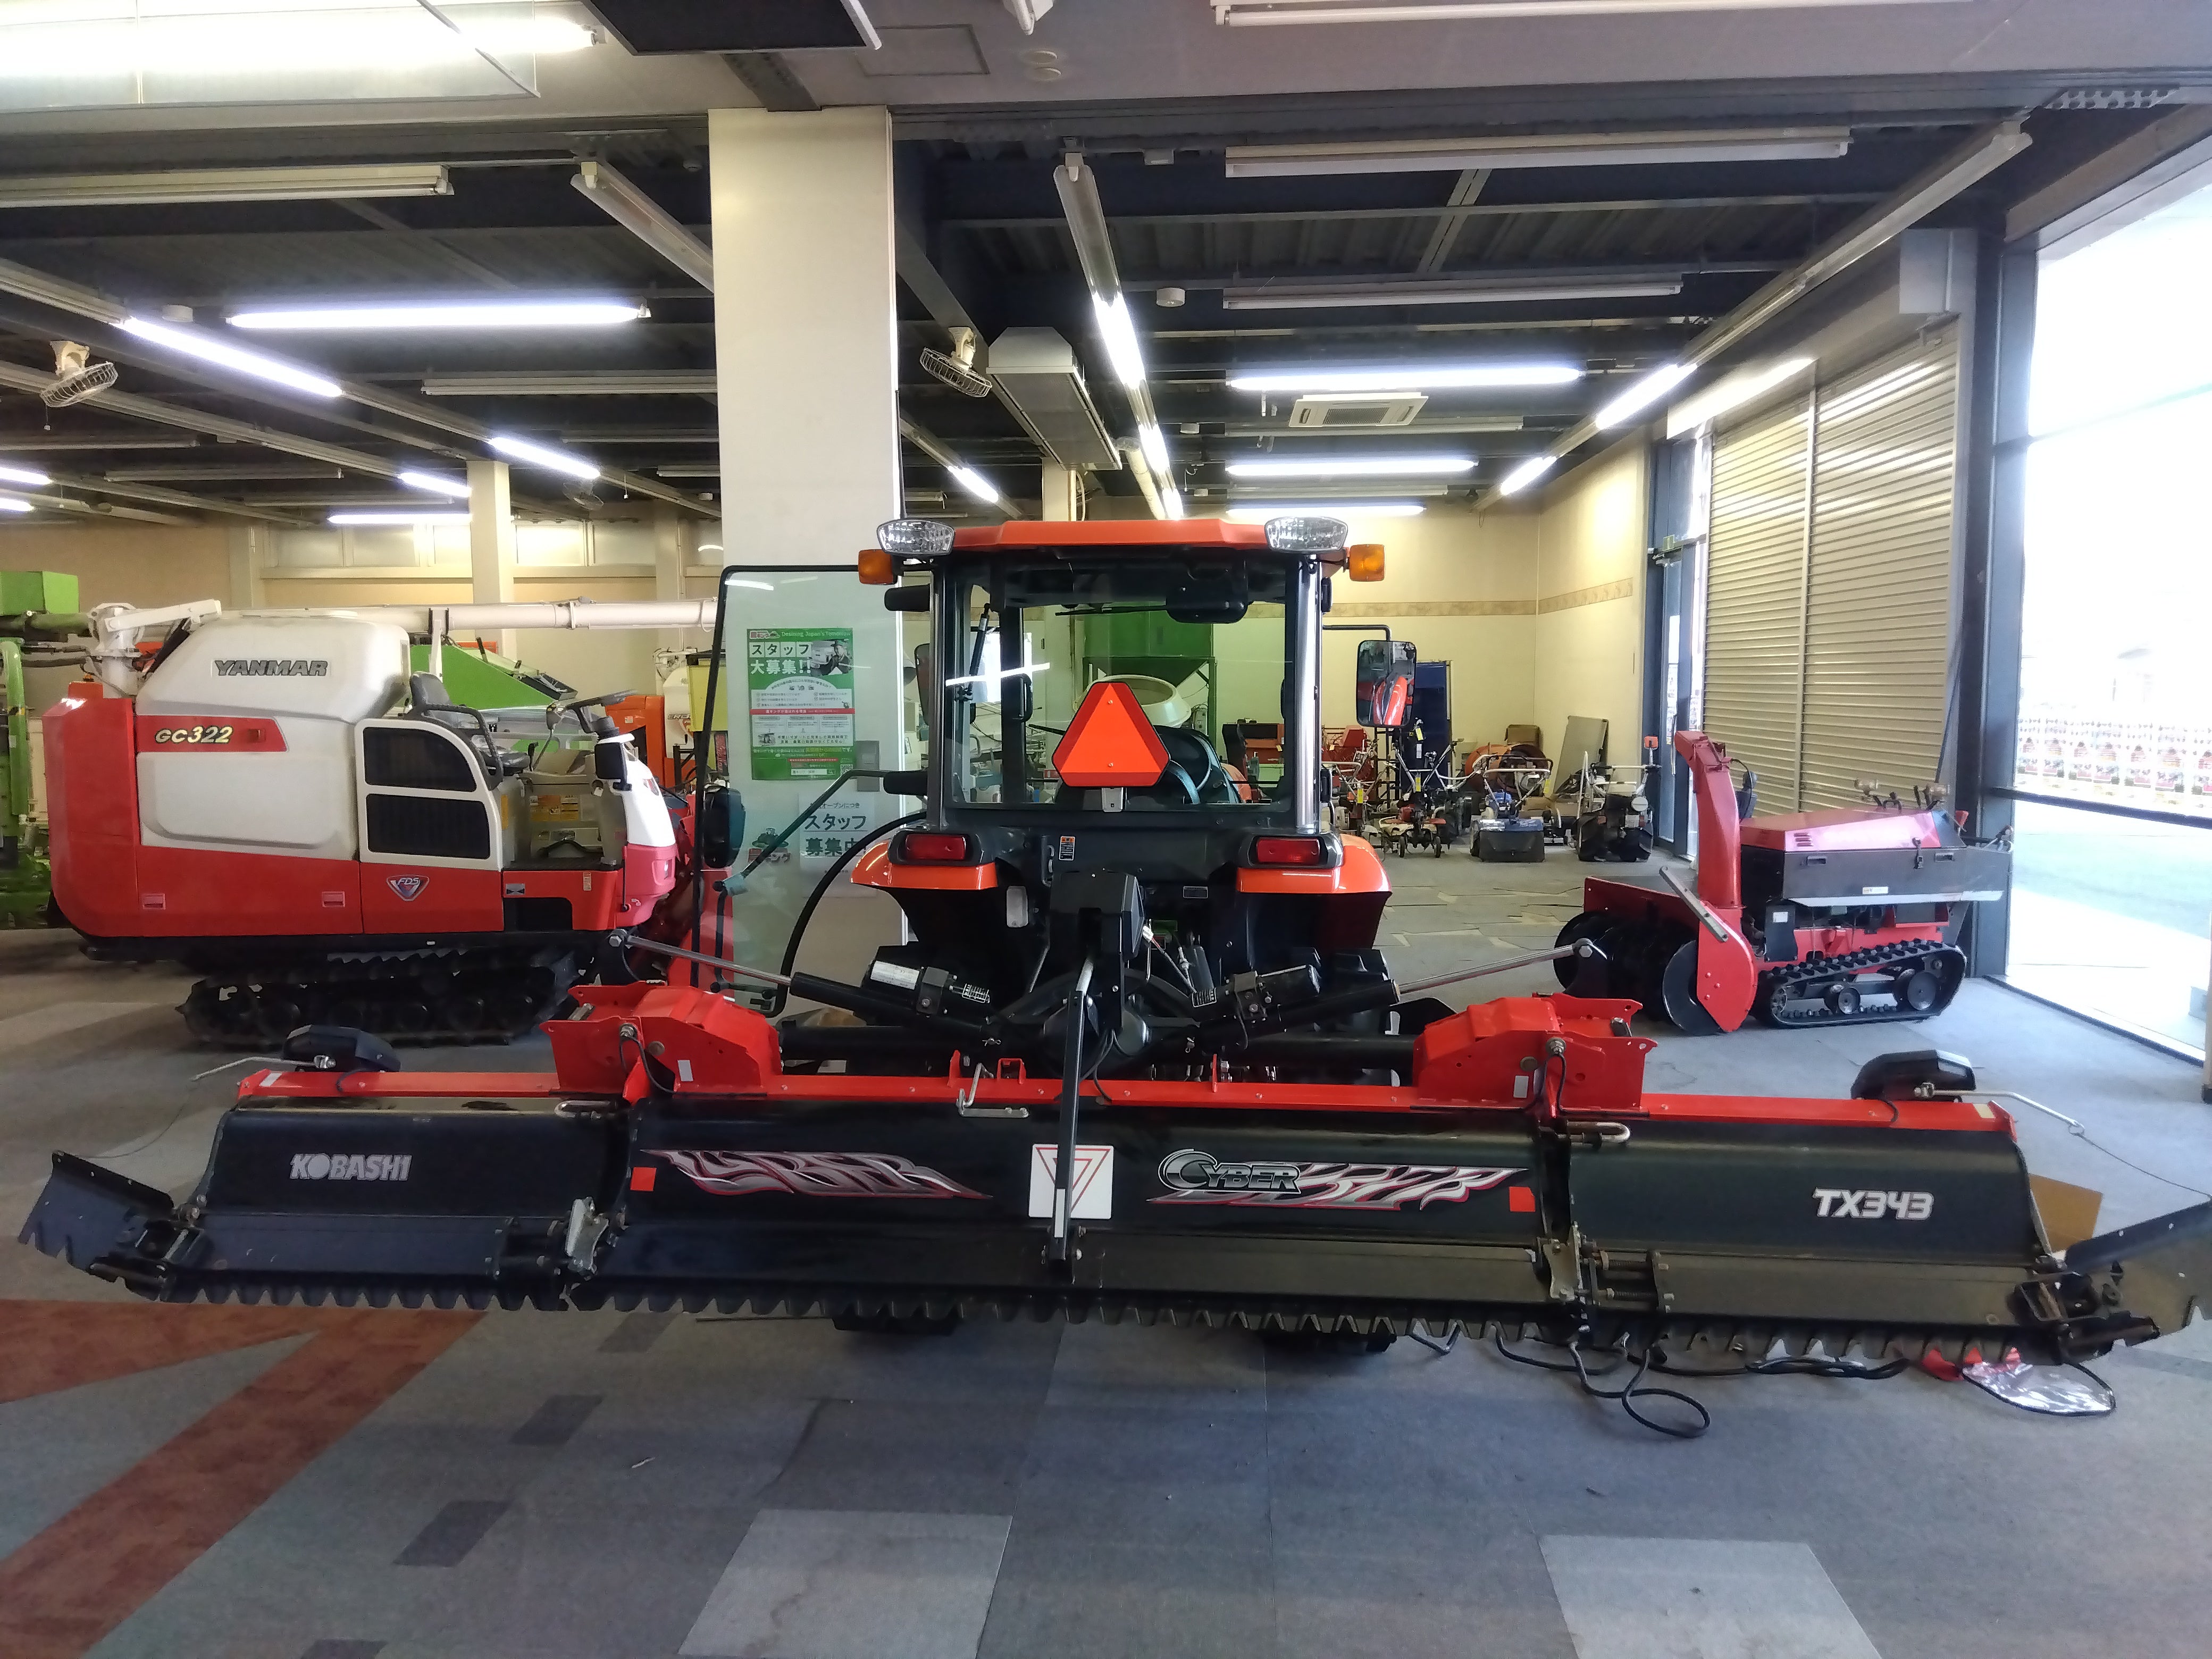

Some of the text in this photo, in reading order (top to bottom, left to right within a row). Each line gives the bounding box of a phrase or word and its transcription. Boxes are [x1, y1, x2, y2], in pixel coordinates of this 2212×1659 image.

[751, 643, 809, 655] スタッフ
[215, 660, 328, 676] YANMAR
[750, 659, 811, 675] 大募集!!
[155, 725, 233, 743] GC322
[805, 814, 866, 830] スタッフ
[290, 1153, 412, 1181] KOBASHI
[1159, 1149, 1301, 1193] CYBER
[1812, 1187, 1934, 1220] TX343
